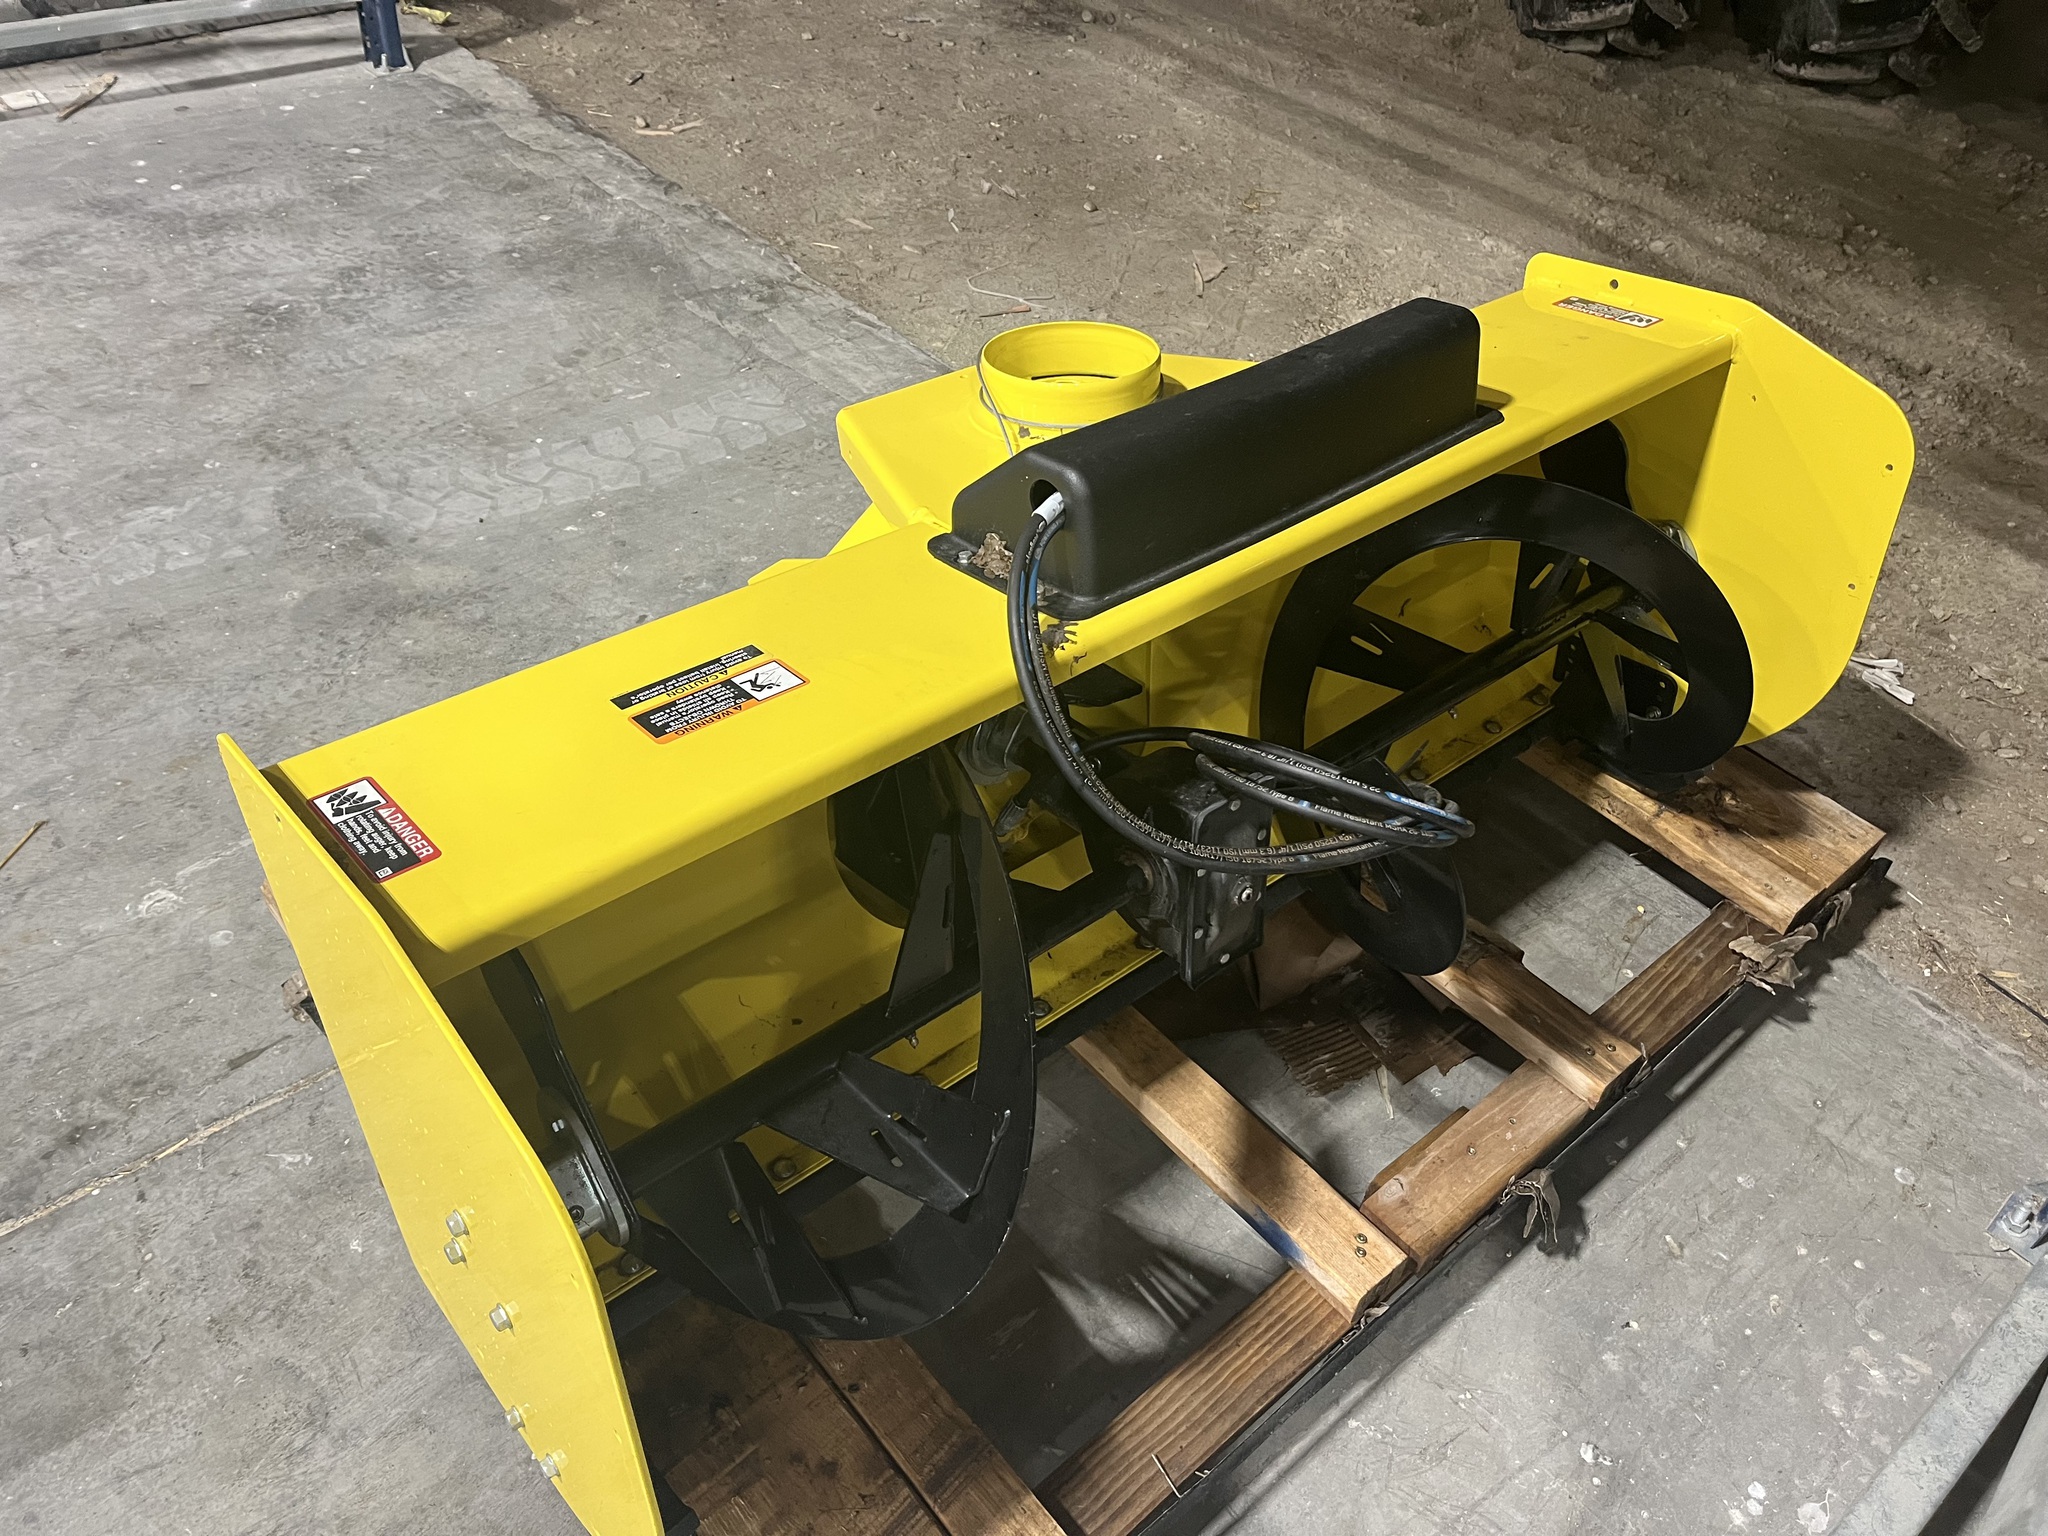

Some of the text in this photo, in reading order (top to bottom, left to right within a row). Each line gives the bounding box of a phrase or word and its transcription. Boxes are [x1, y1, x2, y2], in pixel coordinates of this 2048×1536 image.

[1557, 303, 1604, 317] DANGER
[666, 674, 718, 697] CAUTION
[708, 686, 726, 695] Keep
[711, 689, 730, 698] Keep
[715, 692, 734, 701] Read
[669, 697, 734, 726] THROWN OBJECTS
[713, 701, 734, 712] AVOID
[655, 713, 681, 726] manual
[674, 710, 732, 735] WARNING
[688, 710, 713, 723] INJURY
[664, 721, 687, 732] FROM
[337, 822, 367, 855] clothing away.
[346, 817, 381, 853] hands, feet and
[355, 814, 374, 833] rotating
[370, 832, 386, 848] auger,
[384, 846, 398, 859] keep
[365, 809, 407, 855] To avoid injury from
[385, 812, 434, 858] DANGER
